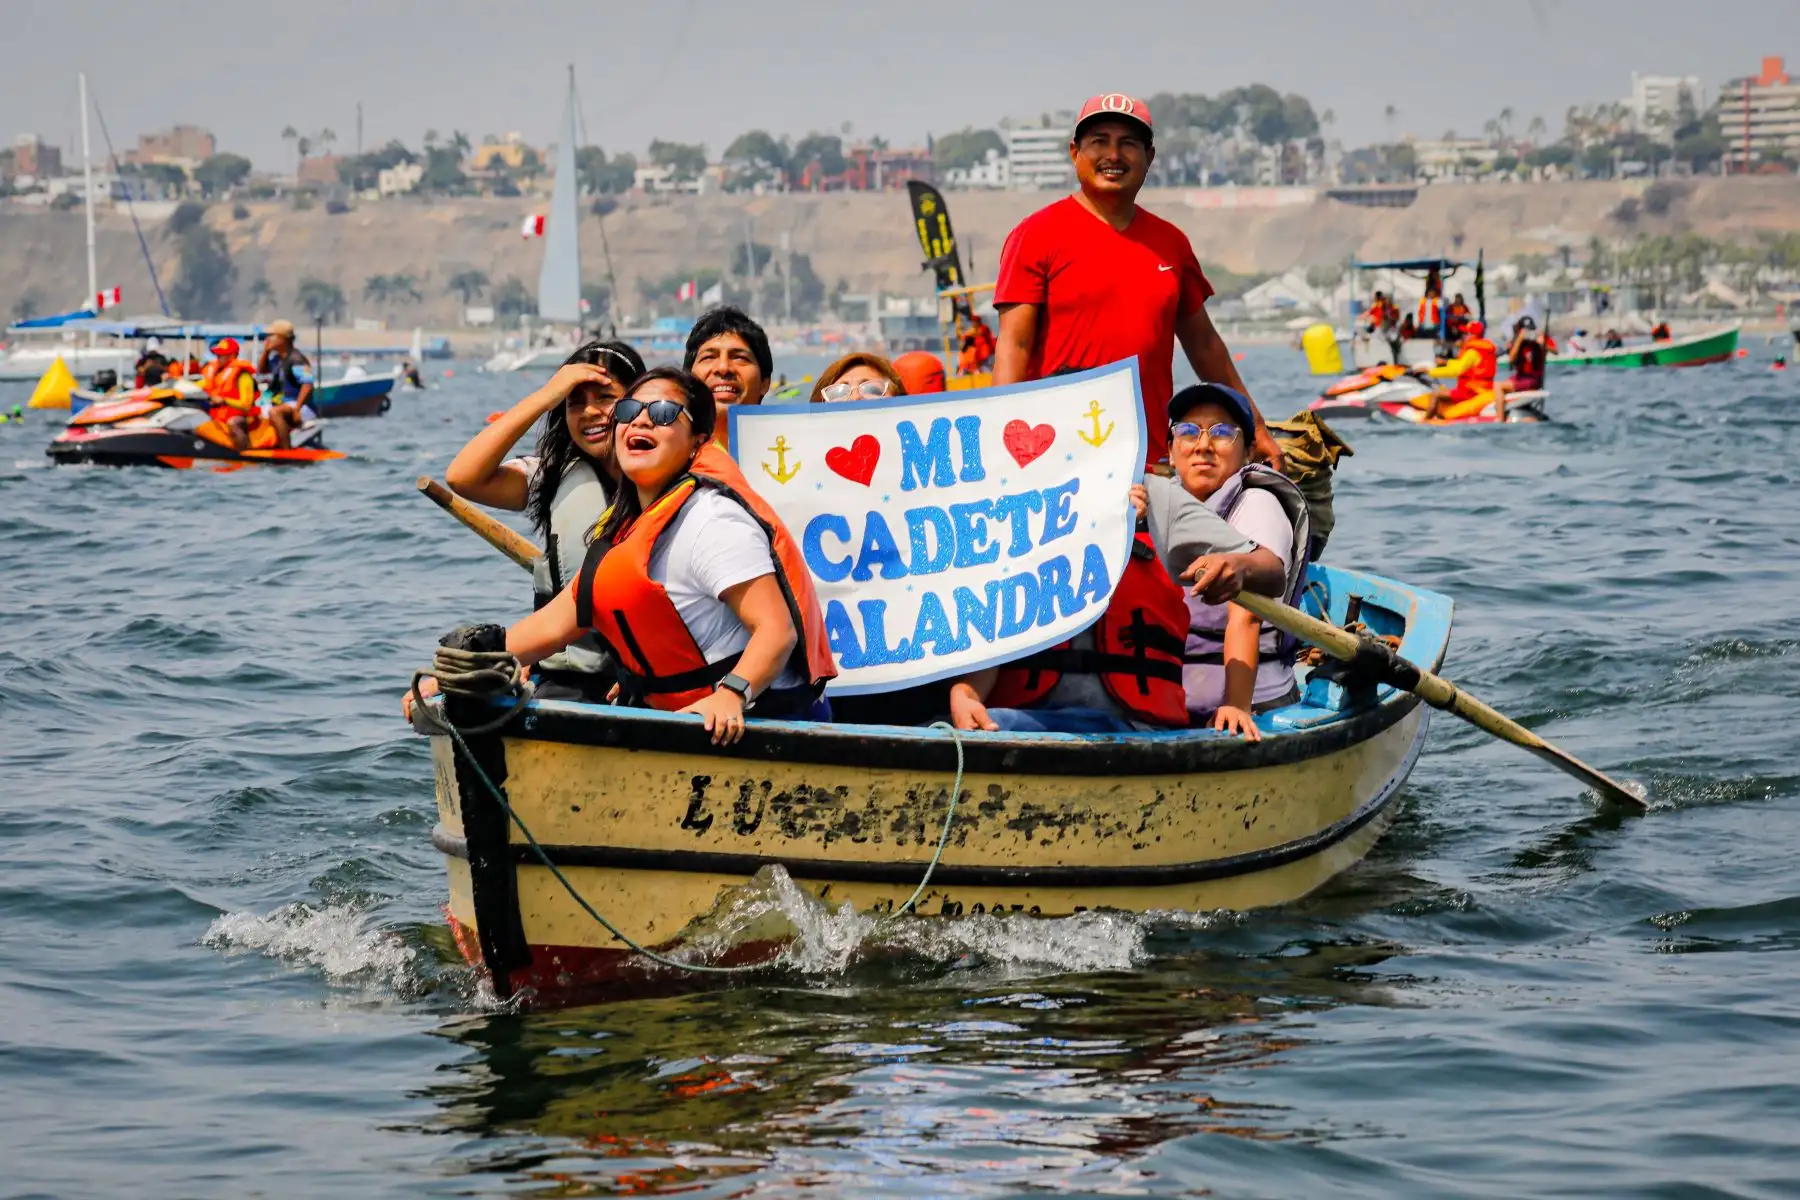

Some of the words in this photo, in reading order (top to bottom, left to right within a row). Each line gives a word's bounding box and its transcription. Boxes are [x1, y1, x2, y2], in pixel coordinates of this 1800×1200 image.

[896, 415, 986, 491] MI
[802, 478, 1080, 583] CADETE
[825, 543, 1112, 670] ALANDRA
